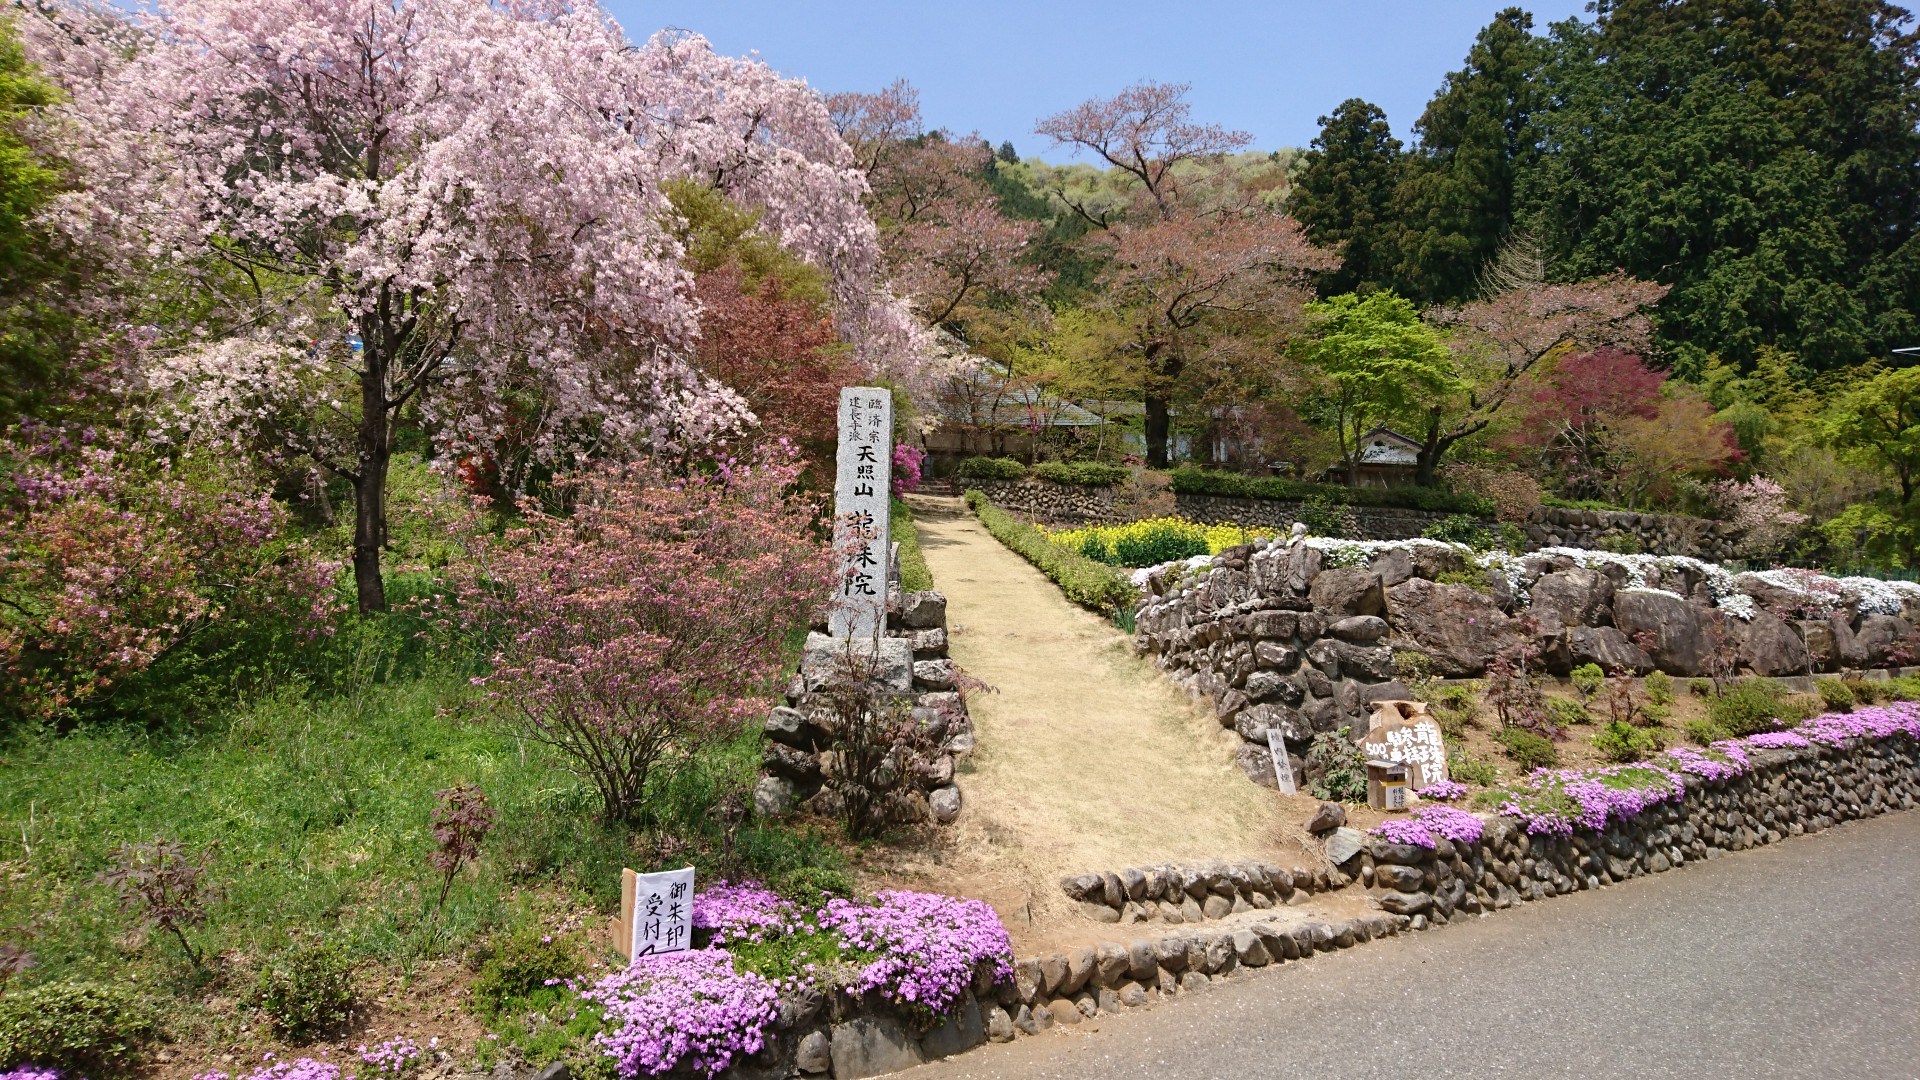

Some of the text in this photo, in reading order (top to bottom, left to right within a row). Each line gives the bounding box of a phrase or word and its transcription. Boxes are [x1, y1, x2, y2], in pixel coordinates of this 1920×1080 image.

[848, 396, 863, 442] 建長寺派
[868, 399, 883, 443] 臨済宗
[854, 445, 877, 498] 天照山
[1413, 721, 1446, 784] 龍珠院
[643, 892, 663, 940] 受付
[666, 881, 687, 947] 御朱印
